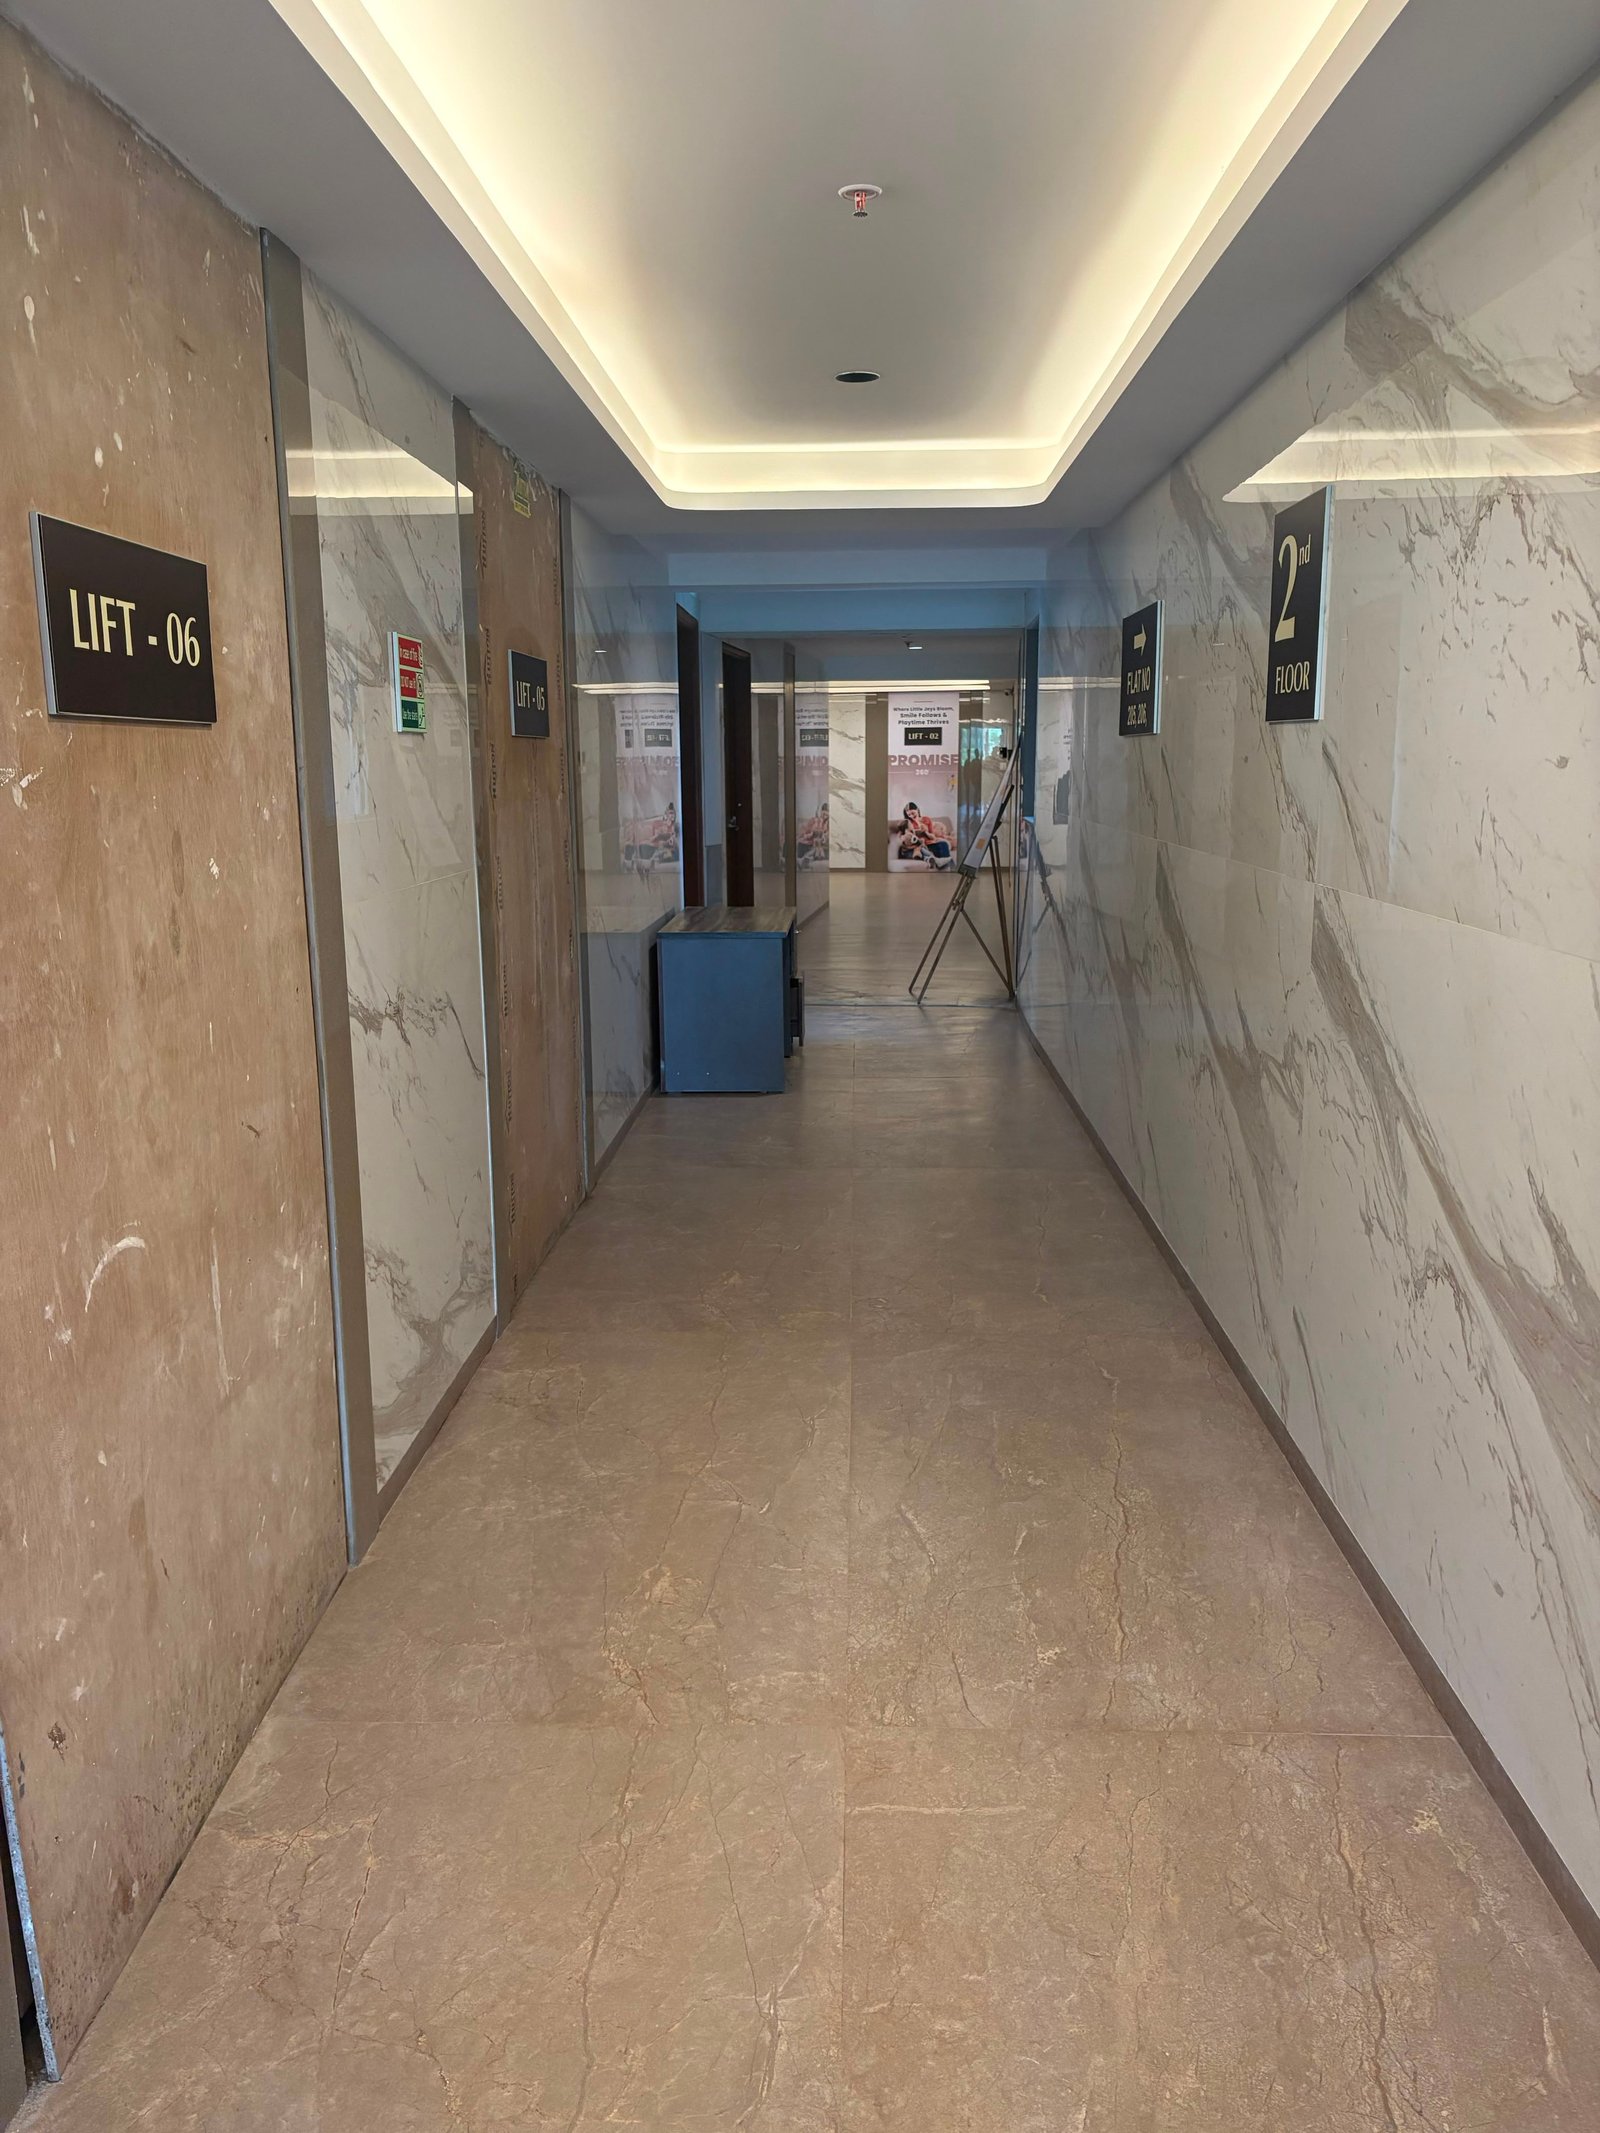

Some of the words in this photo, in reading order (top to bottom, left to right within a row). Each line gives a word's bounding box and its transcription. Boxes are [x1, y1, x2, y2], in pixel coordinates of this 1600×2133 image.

[1274, 534, 1312, 643] 2nd
[69, 588, 136, 657] LIFT
[147, 634, 158, 646] -
[166, 612, 201, 667] 06
[1127, 669, 1141, 695] FLAT
[1141, 665, 1151, 692] NO
[1274, 660, 1310, 695] FLOOR
[516, 680, 531, 708] LIFT
[536, 685, 545, 711] 05
[908, 732, 924, 740] LIFT
[929, 732, 940, 740] 02
[888, 753, 959, 766] PROMISE
